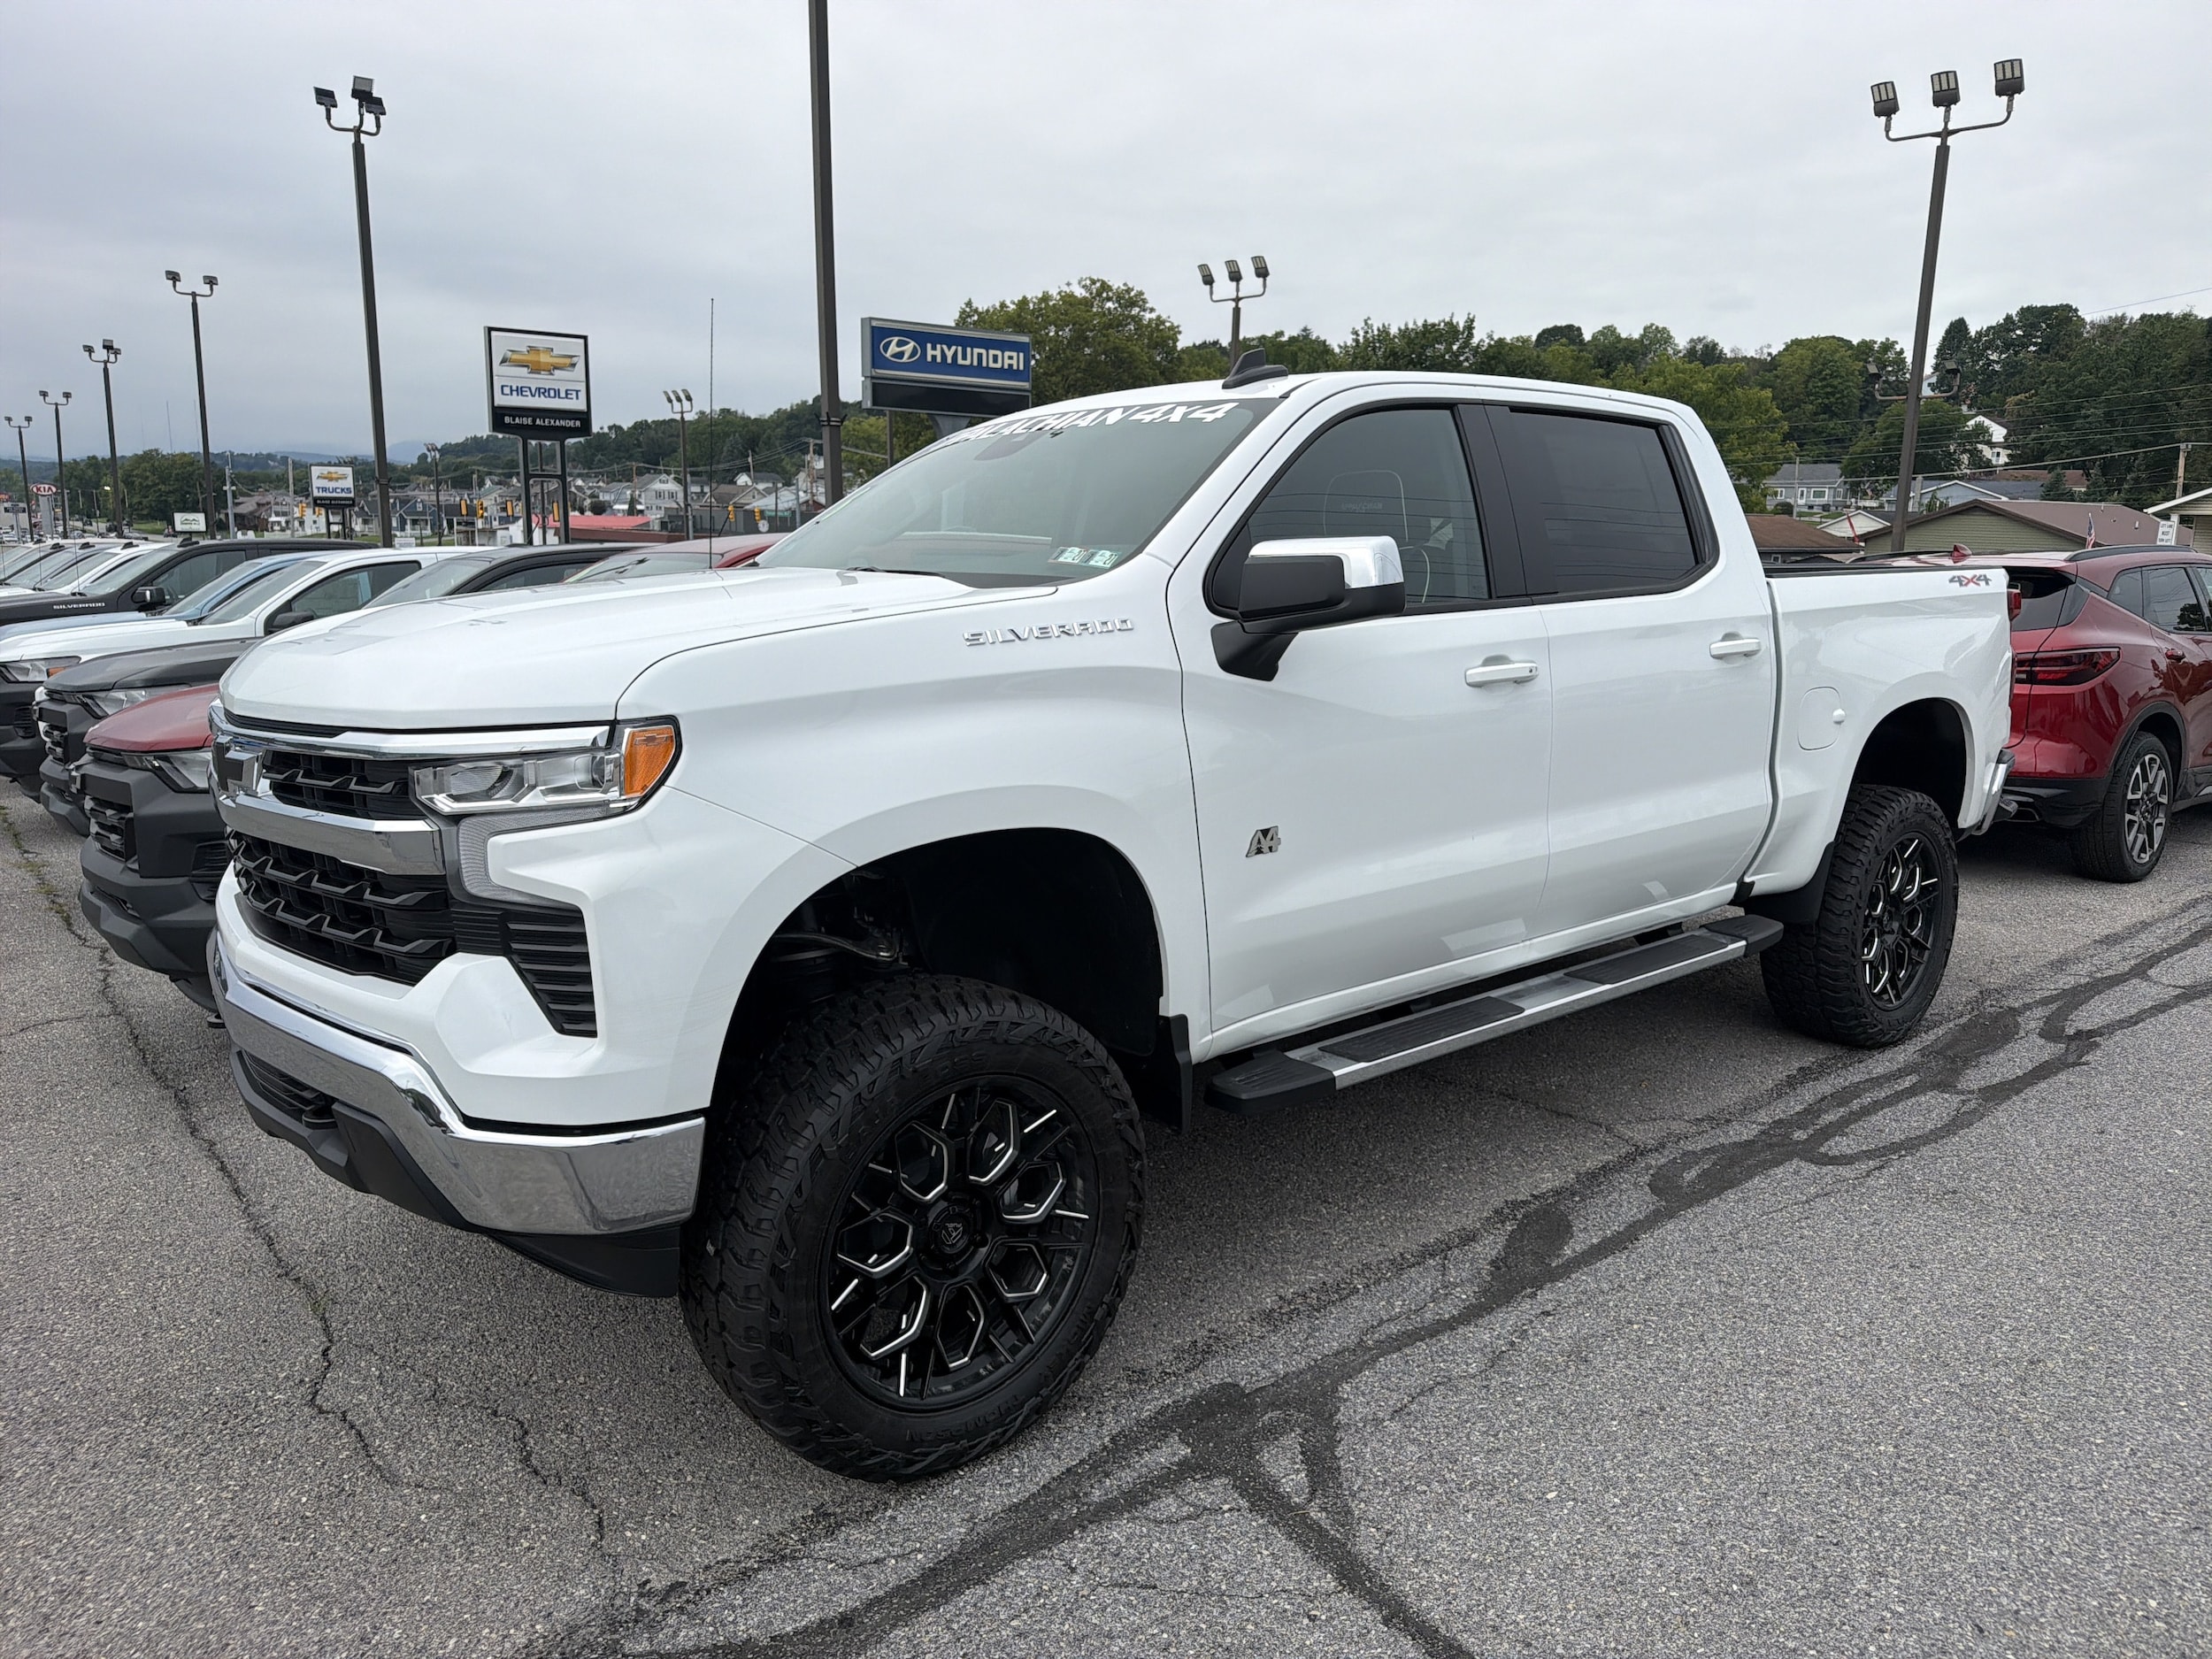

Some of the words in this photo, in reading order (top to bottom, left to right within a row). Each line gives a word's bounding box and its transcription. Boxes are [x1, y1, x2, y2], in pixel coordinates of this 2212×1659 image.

[926, 342, 1025, 371] HYUNDAI
[500, 384, 581, 401] CHEVROLET
[503, 415, 534, 426] BLAISE
[535, 418, 581, 428] ALEXANDER
[315, 486, 352, 495] TRUCKS
[962, 618, 1134, 647] SILVERADO
